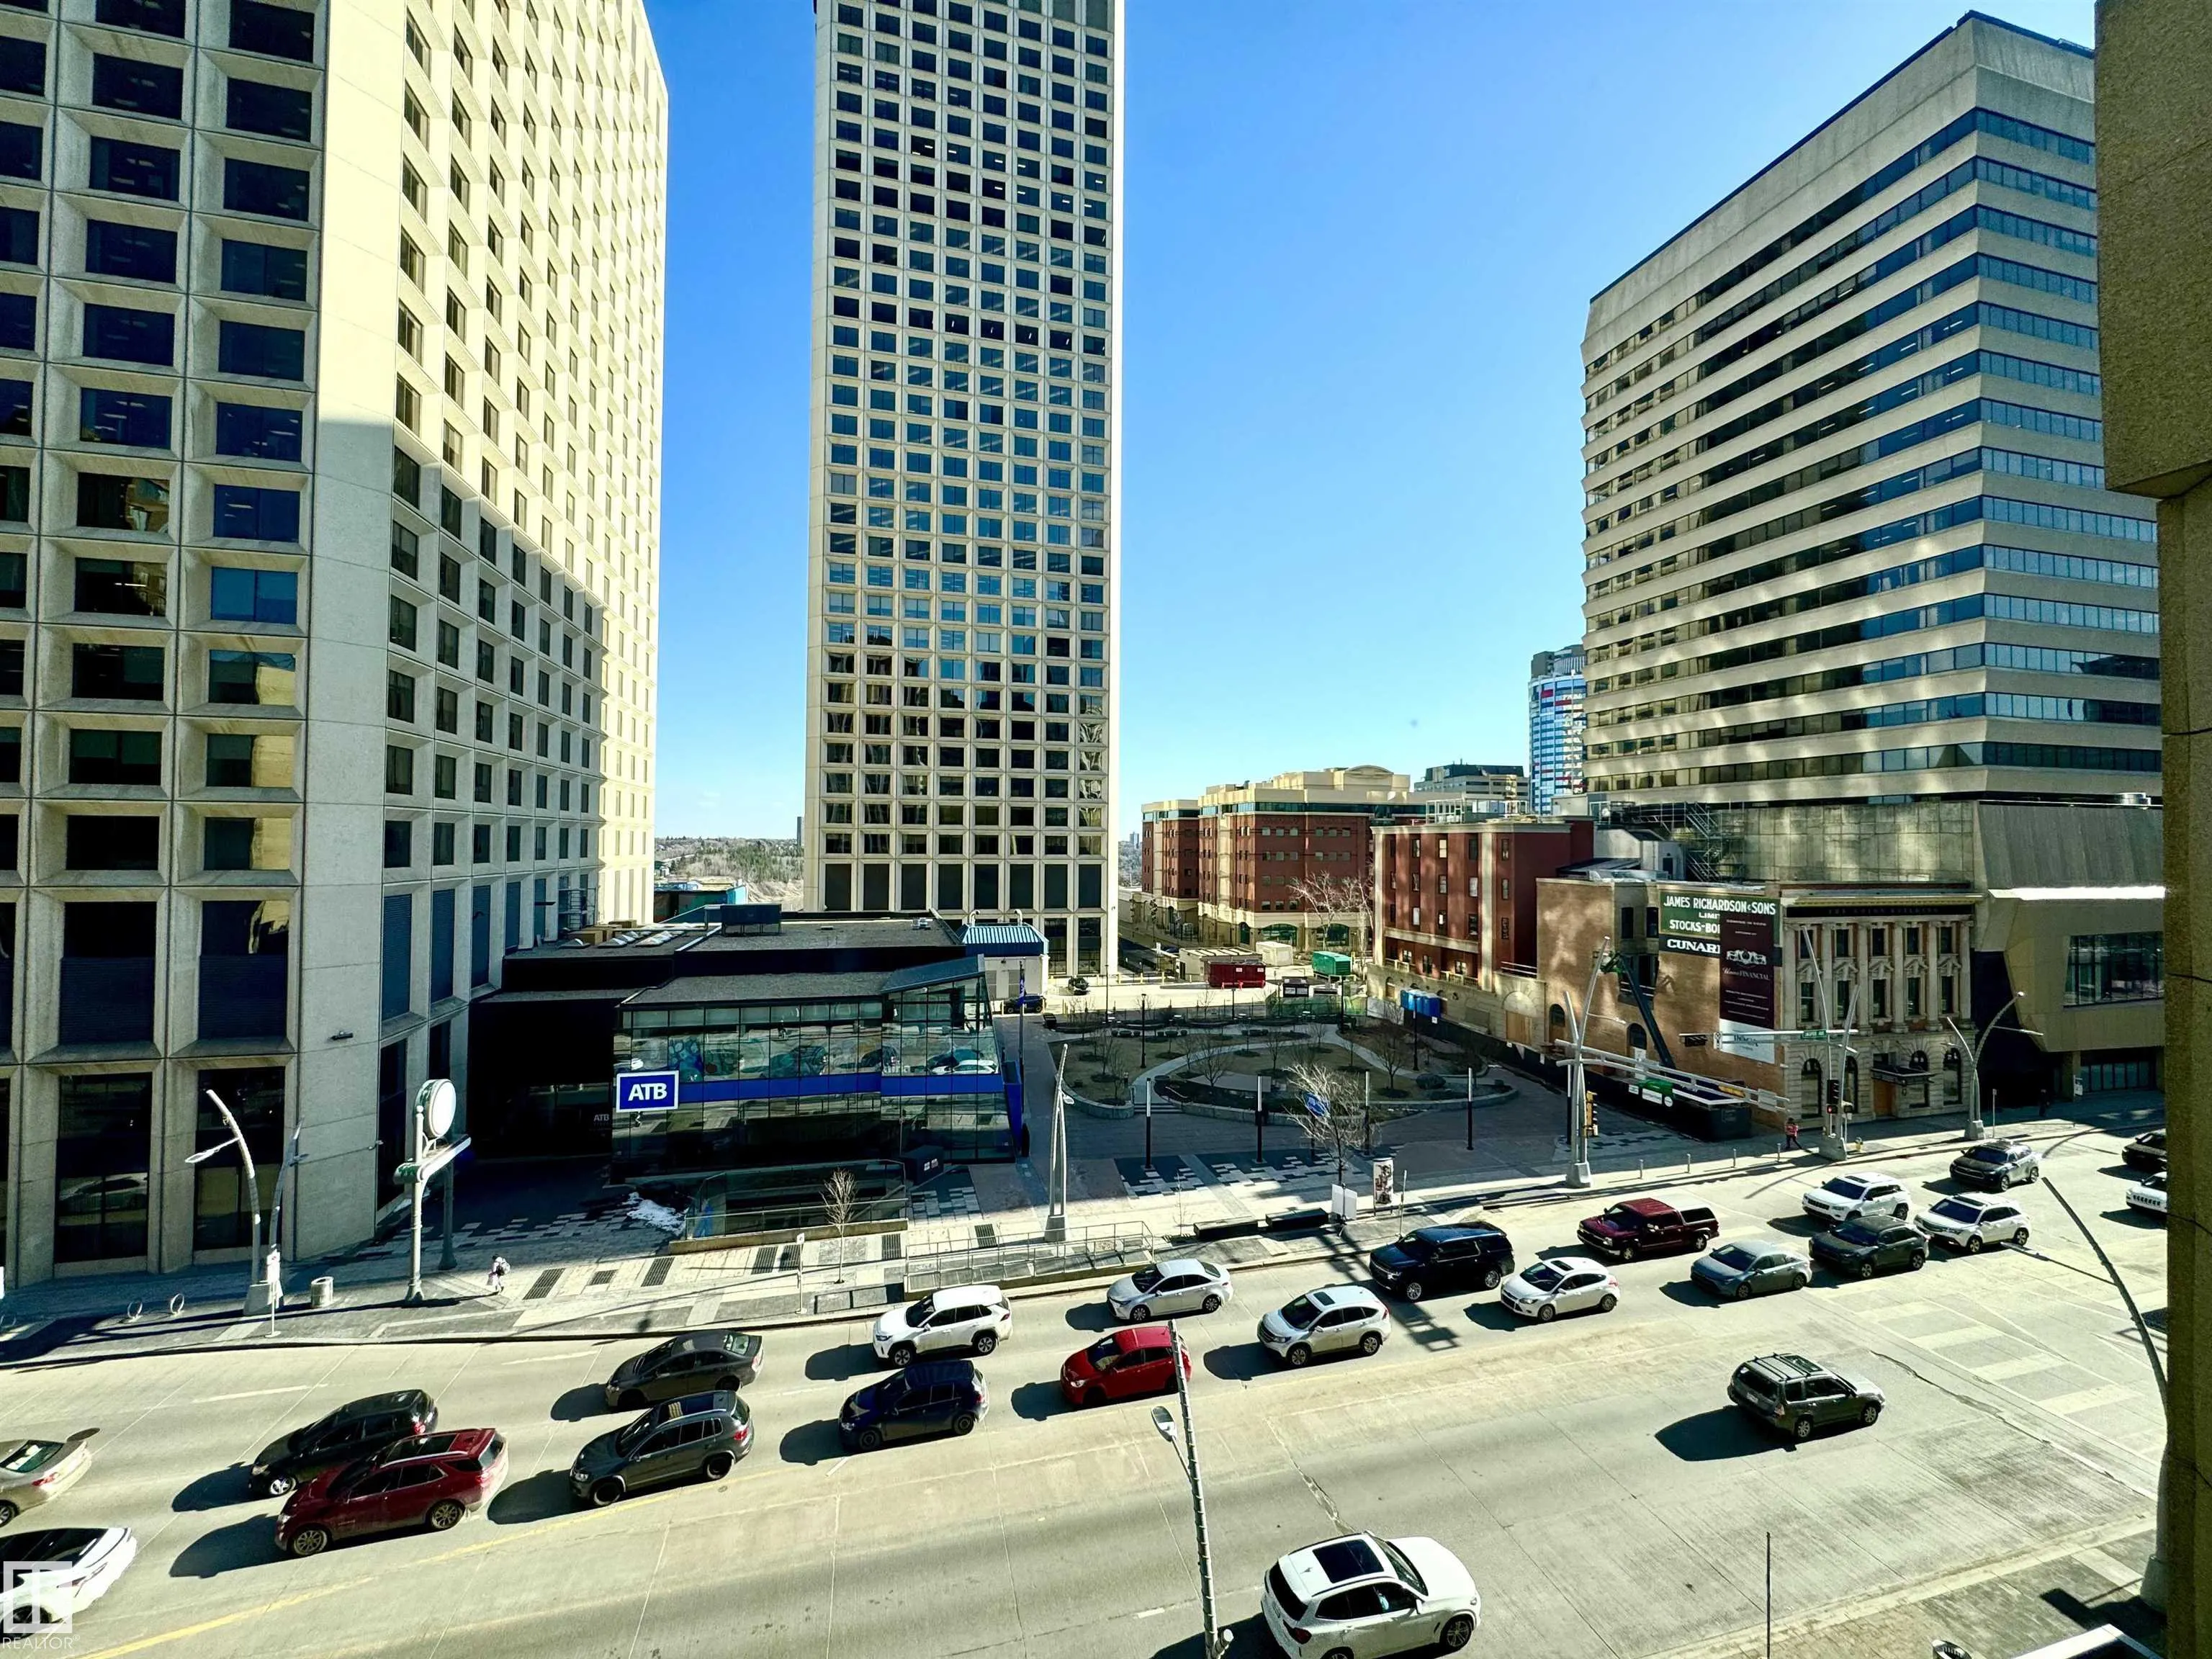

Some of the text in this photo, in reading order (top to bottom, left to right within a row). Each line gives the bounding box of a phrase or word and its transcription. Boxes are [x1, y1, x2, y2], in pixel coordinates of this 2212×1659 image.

[1663, 896, 1691, 908] JAMES
[1693, 898, 1747, 913] RICHARDSON
[1751, 902, 1776, 915] SONS
[628, 1082, 667, 1102] ATB
[593, 1113, 610, 1122] ATB
